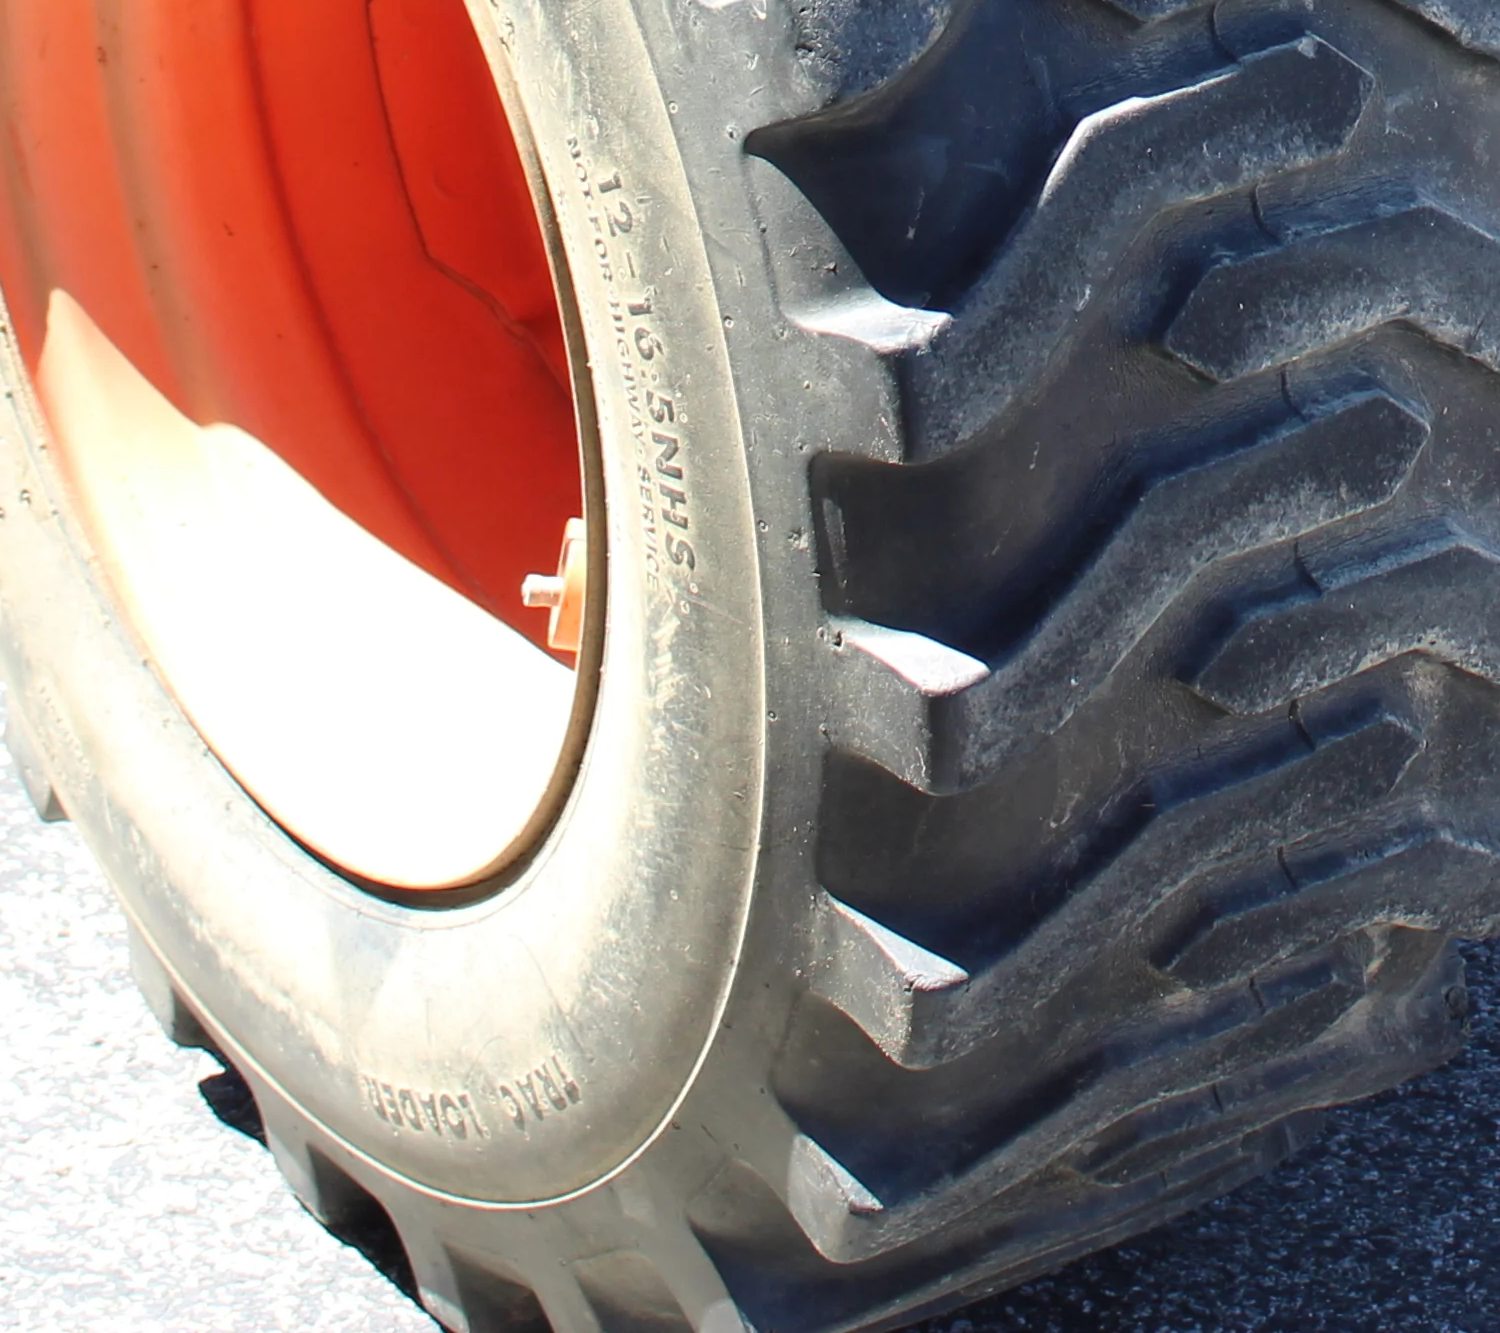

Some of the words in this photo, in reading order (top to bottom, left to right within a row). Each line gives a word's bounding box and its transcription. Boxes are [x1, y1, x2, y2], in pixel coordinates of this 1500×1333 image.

[565, 134, 594, 207] NOT
[588, 213, 614, 286] FOR
[608, 297, 646, 445] HIGHWAY
[634, 465, 662, 593] SERVICE
[360, 1071, 490, 1141] LOADER
[498, 1053, 583, 1131] TRAC
